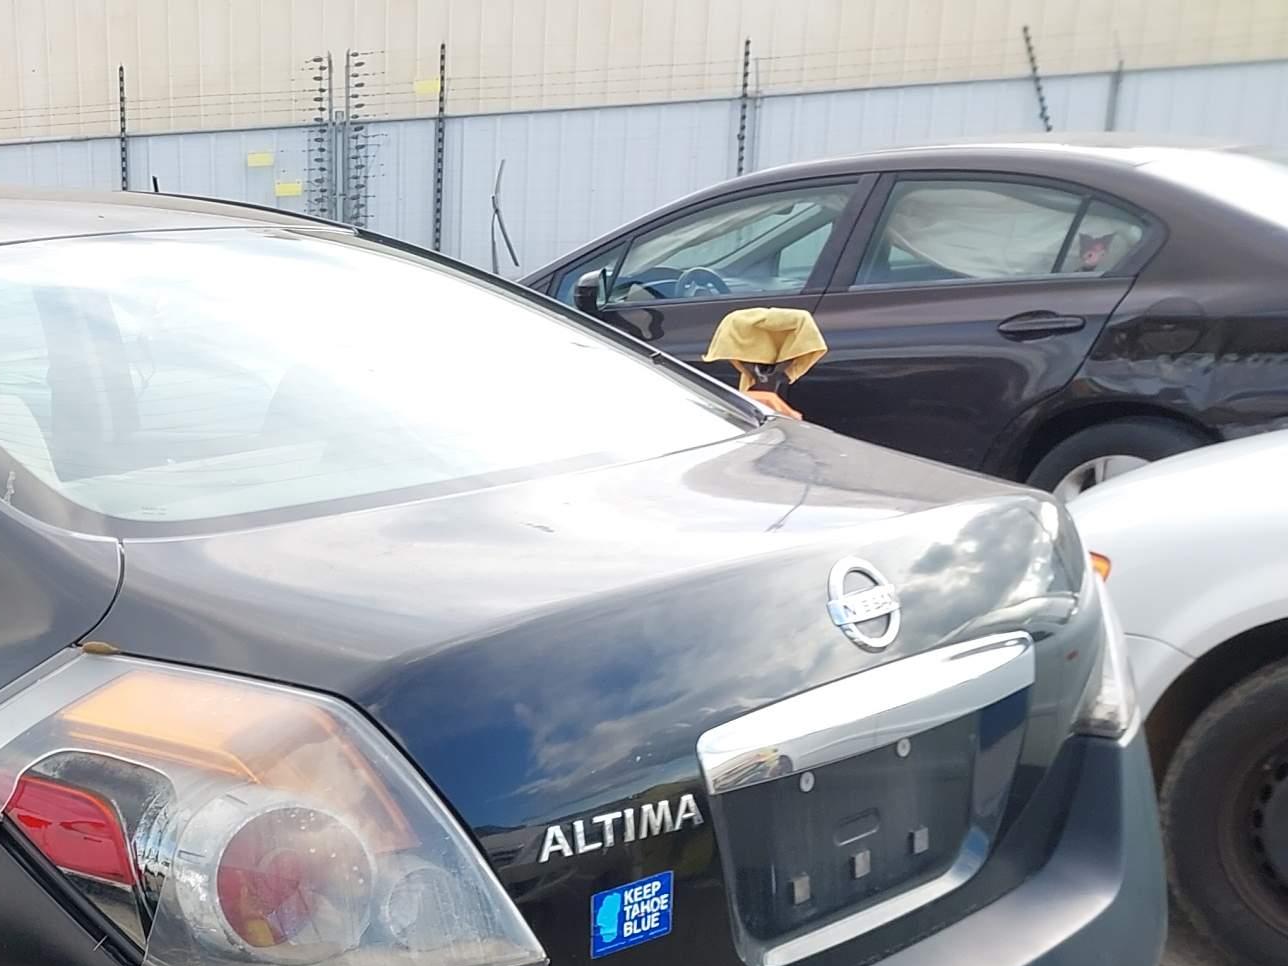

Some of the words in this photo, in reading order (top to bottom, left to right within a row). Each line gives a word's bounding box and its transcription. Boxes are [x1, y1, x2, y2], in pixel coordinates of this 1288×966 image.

[539, 793, 705, 863] ALTIMA
[623, 880, 661, 906] KEEP
[623, 893, 669, 922] TAHOE
[623, 912, 661, 938] BLUE
